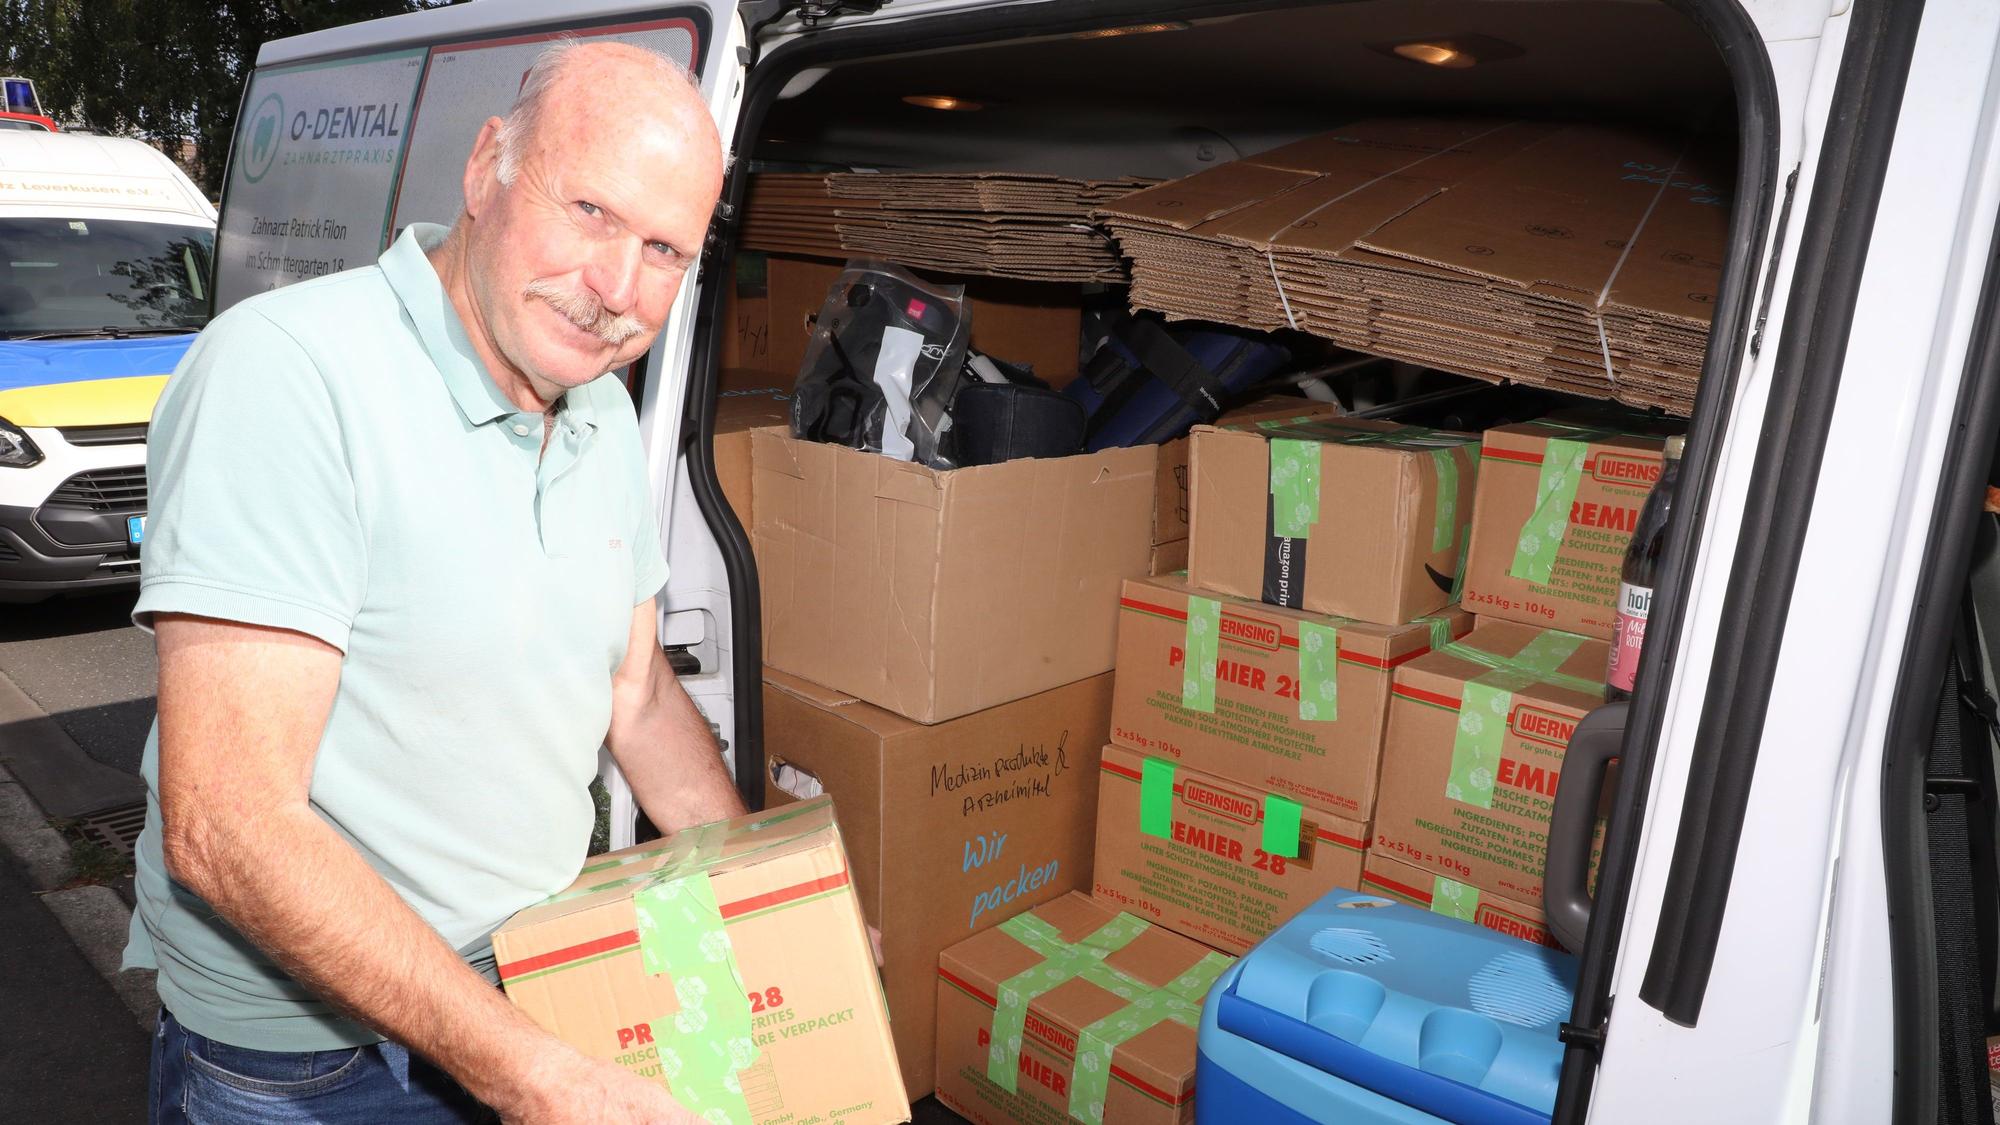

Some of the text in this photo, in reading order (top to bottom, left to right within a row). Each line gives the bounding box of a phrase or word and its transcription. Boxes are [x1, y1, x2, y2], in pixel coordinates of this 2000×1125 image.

[291, 103, 399, 141] O-DENTAL
[283, 149, 394, 166] ZAHNARZTPRAXIS
[22, 182, 121, 196] Leverkusen
[251, 217, 347, 241] Zahnarzt Patrick Filon
[1571, 528, 1612, 542] FRISCHE
[1552, 567, 1593, 583] UTATEN:
[1528, 584, 1600, 605] INGREDIENSER:
[1572, 581, 1616, 599] POMMES
[1219, 618, 1275, 644] ERNSING
[1169, 646, 1265, 692] PMIER
[1236, 701, 1266, 718] FRENCH
[1267, 711, 1289, 727] FRIES
[1520, 711, 1572, 740] WERN
[1274, 735, 1327, 761] PROTECTRICE
[1519, 742, 1533, 753] Für
[1533, 744, 1552, 759] gute
[1188, 785, 1253, 819] WERNSING
[1452, 808, 1526, 838] INGREDIENTS:
[1460, 821, 1510, 846] ZUTATEN:
[962, 831, 1008, 873] Wir
[1170, 818, 1287, 879] EMIER 28
[1415, 818, 1484, 848] INGRÉDIENTS:
[1486, 840, 1536, 863] POMMES
[1440, 838, 1519, 871] INGREDIENSER:
[1140, 842, 1164, 858] UNTER
[1248, 875, 1290, 901] VERPACKT
[1168, 842, 1260, 881] FRISCHE POMMES FRITES
[1406, 842, 1422, 862] kg
[1438, 854, 1453, 871] 10
[1455, 857, 1470, 880] kg
[969, 859, 1059, 929] packen
[1137, 897, 1149, 911] 10
[1149, 901, 1161, 919] kg
[1170, 885, 1202, 905] POMMES
[1240, 890, 1264, 909] PALM
[1265, 899, 1280, 915] OIL
[748, 986, 784, 1015] 28
[779, 1007, 855, 1043] VERPACKT
[1024, 1016, 1076, 1054] ERNSING
[977, 1029, 1067, 1098] PMIER
[829, 1100, 874, 1121] Germany
